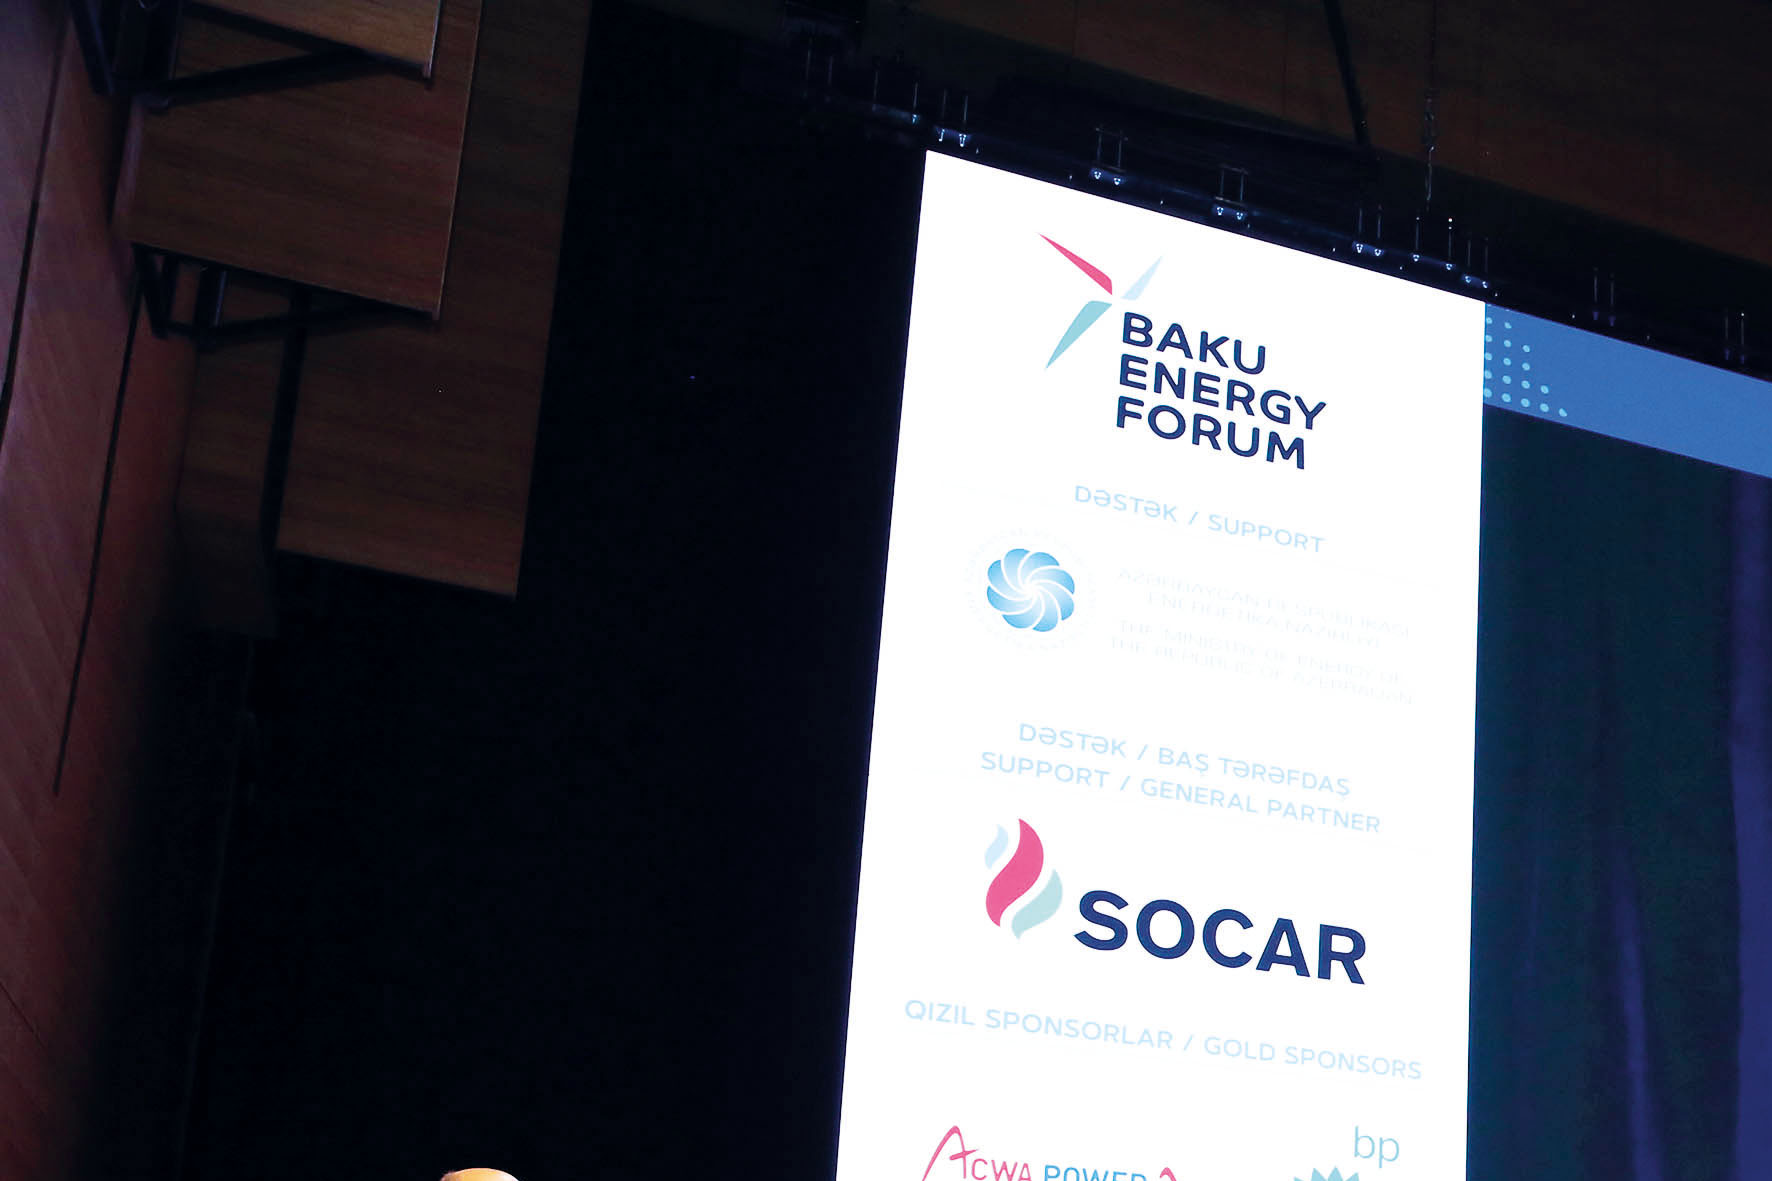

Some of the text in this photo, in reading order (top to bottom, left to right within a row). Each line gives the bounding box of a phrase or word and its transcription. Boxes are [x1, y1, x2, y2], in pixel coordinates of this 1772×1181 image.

[1123, 311, 1267, 375] BAKU
[1120, 353, 1327, 430] ENERGY
[1116, 395, 1305, 470] FORUM
[1074, 484, 1176, 523] DƏSTƏK
[1208, 513, 1327, 553] SUPPORT
[981, 752, 1111, 790] SUPPORT
[1141, 779, 1258, 815] GENERAL
[1267, 800, 1381, 833] PARTNER
[1018, 723, 1127, 759] DƏSTƏK
[1159, 747, 1208, 778] BAŞ
[1219, 757, 1352, 800] TƏRƏFDAŞ
[1074, 889, 1366, 985] SOCAR
[905, 999, 975, 1026] QIZIL
[985, 1008, 1174, 1050] SPONSORLAR
[1204, 1036, 1276, 1063] GOLD
[1285, 1046, 1422, 1080] SPONSORS
[1354, 1125, 1400, 1169] bp
